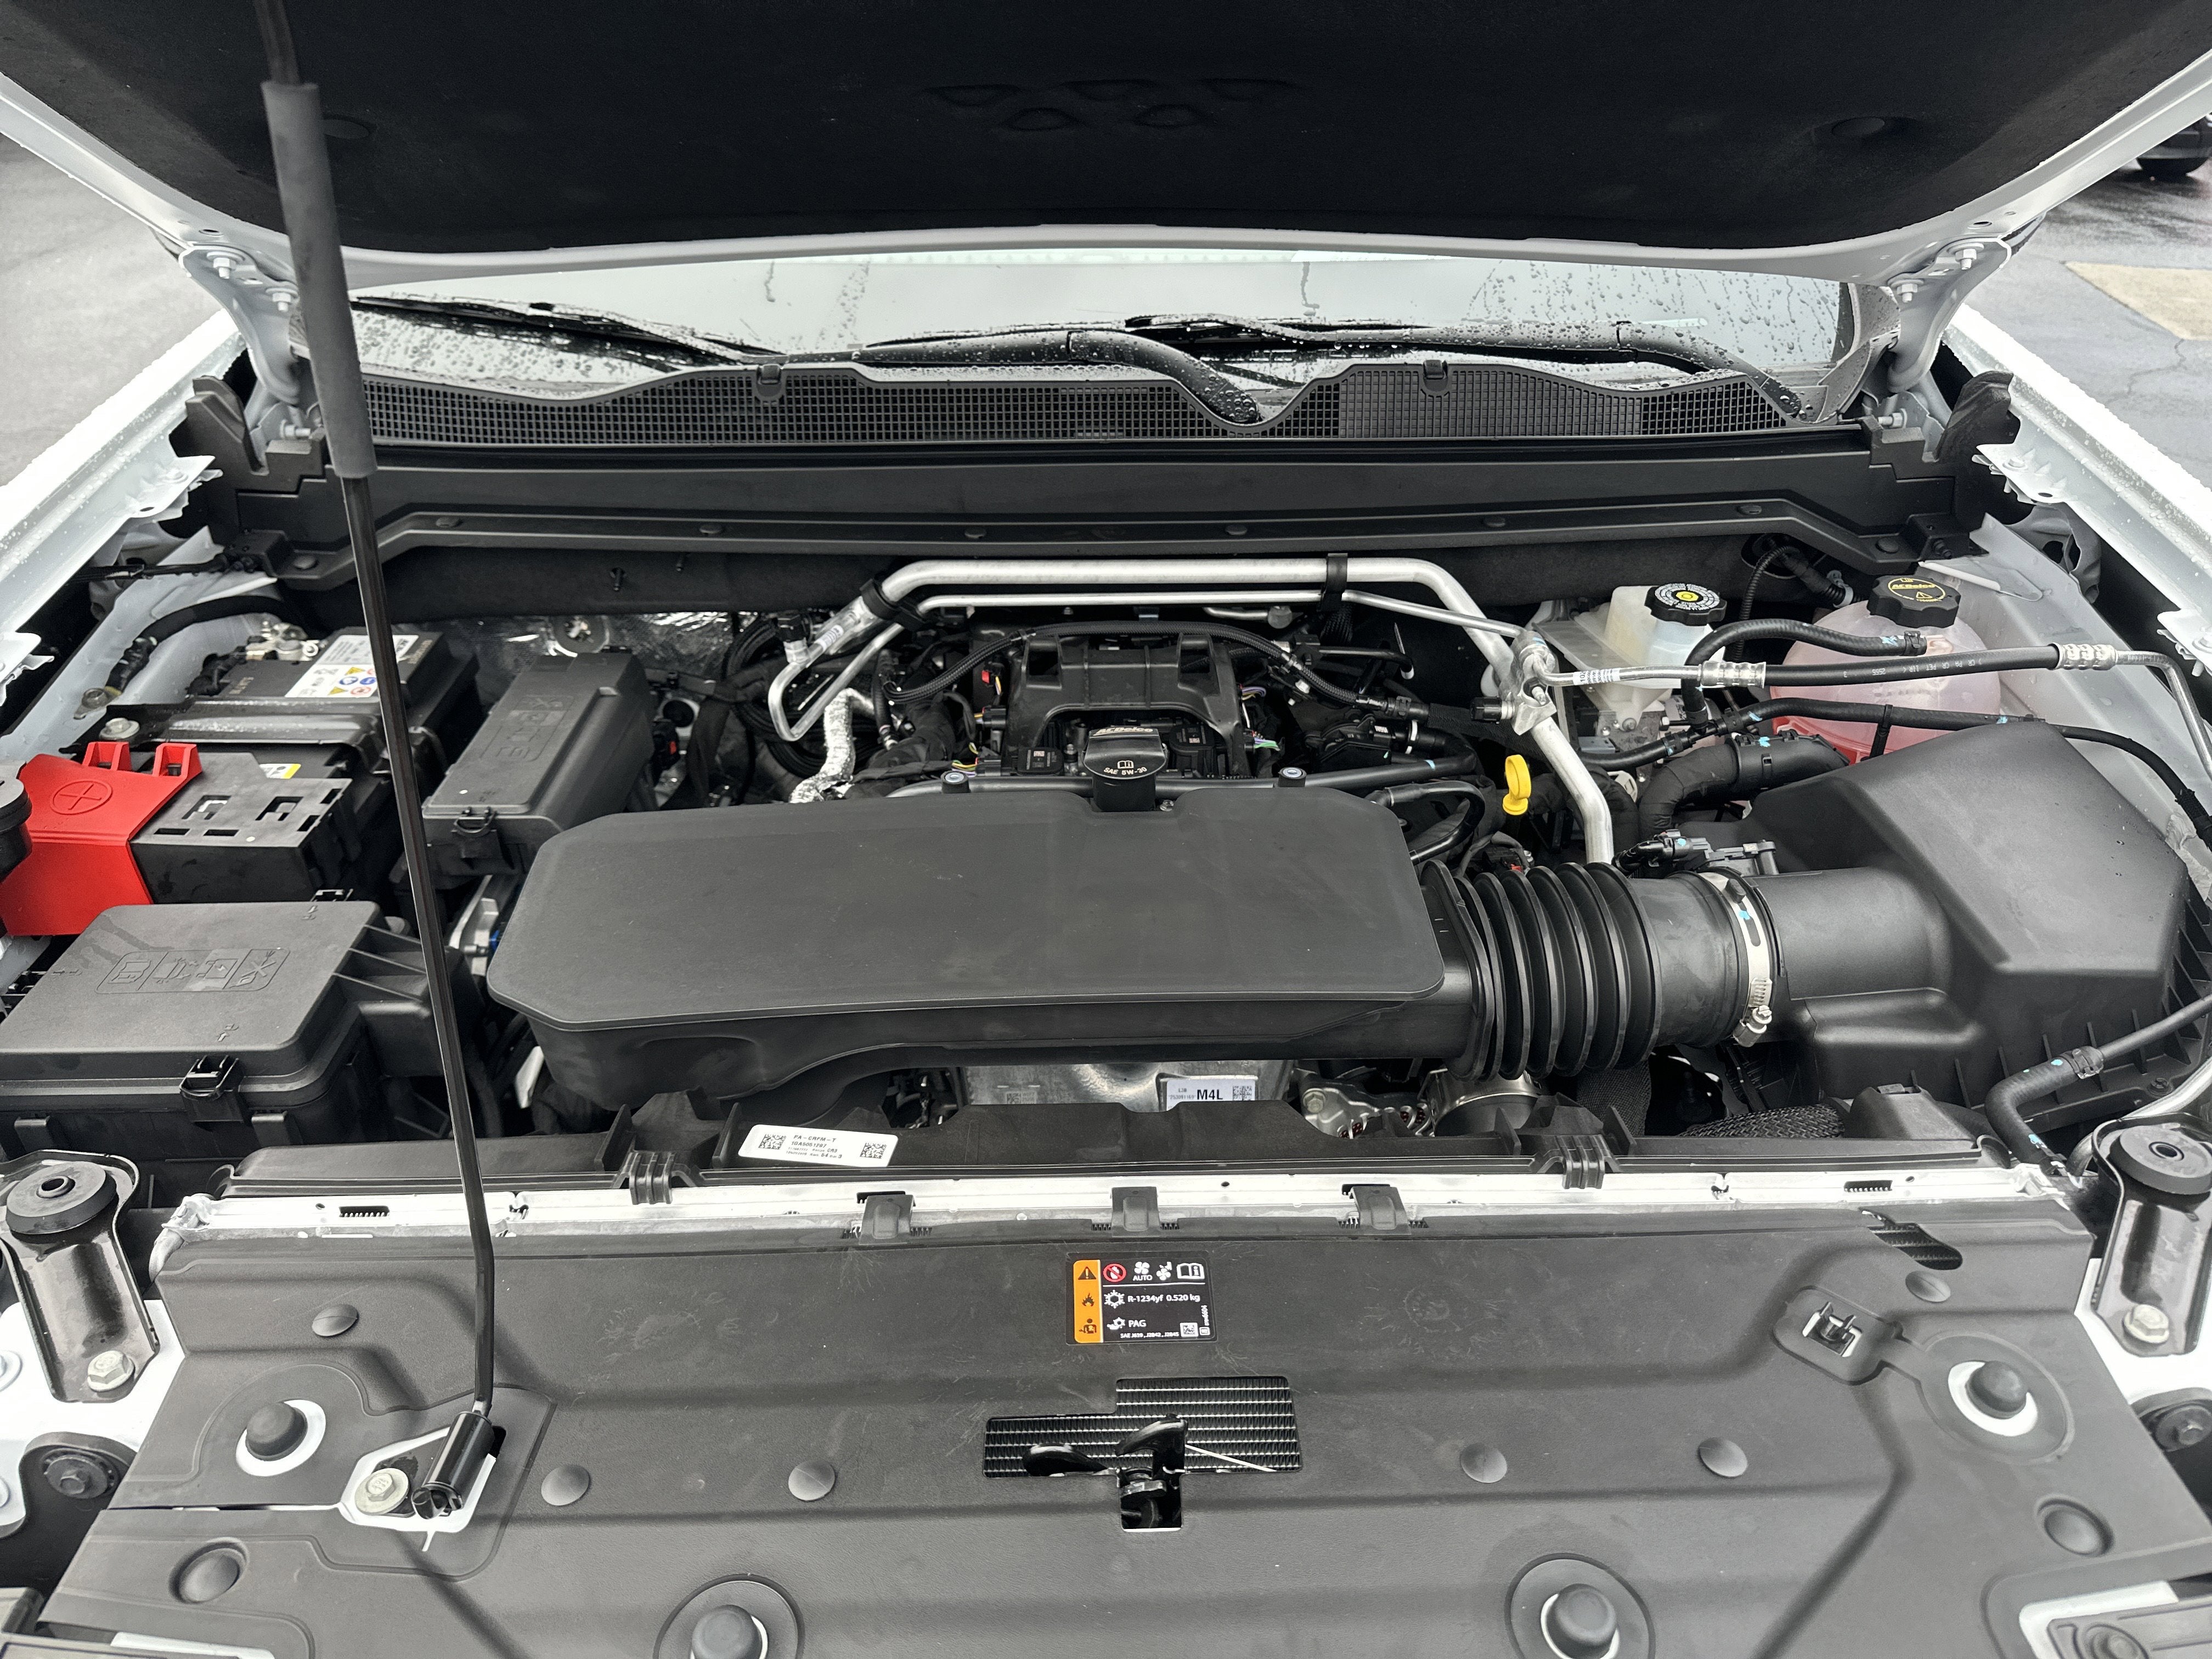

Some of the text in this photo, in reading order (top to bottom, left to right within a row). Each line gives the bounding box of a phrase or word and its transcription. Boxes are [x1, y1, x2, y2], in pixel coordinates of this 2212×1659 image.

[1093, 727, 1153, 736] ACDelco
[1121, 766, 1148, 775] 5W-30
[1197, 1089, 1223, 1100] M4L
[1127, 1295, 1164, 1303] R-1234yf
[1189, 1294, 1200, 1302] kg
[1128, 1319, 1147, 1328] PAG
